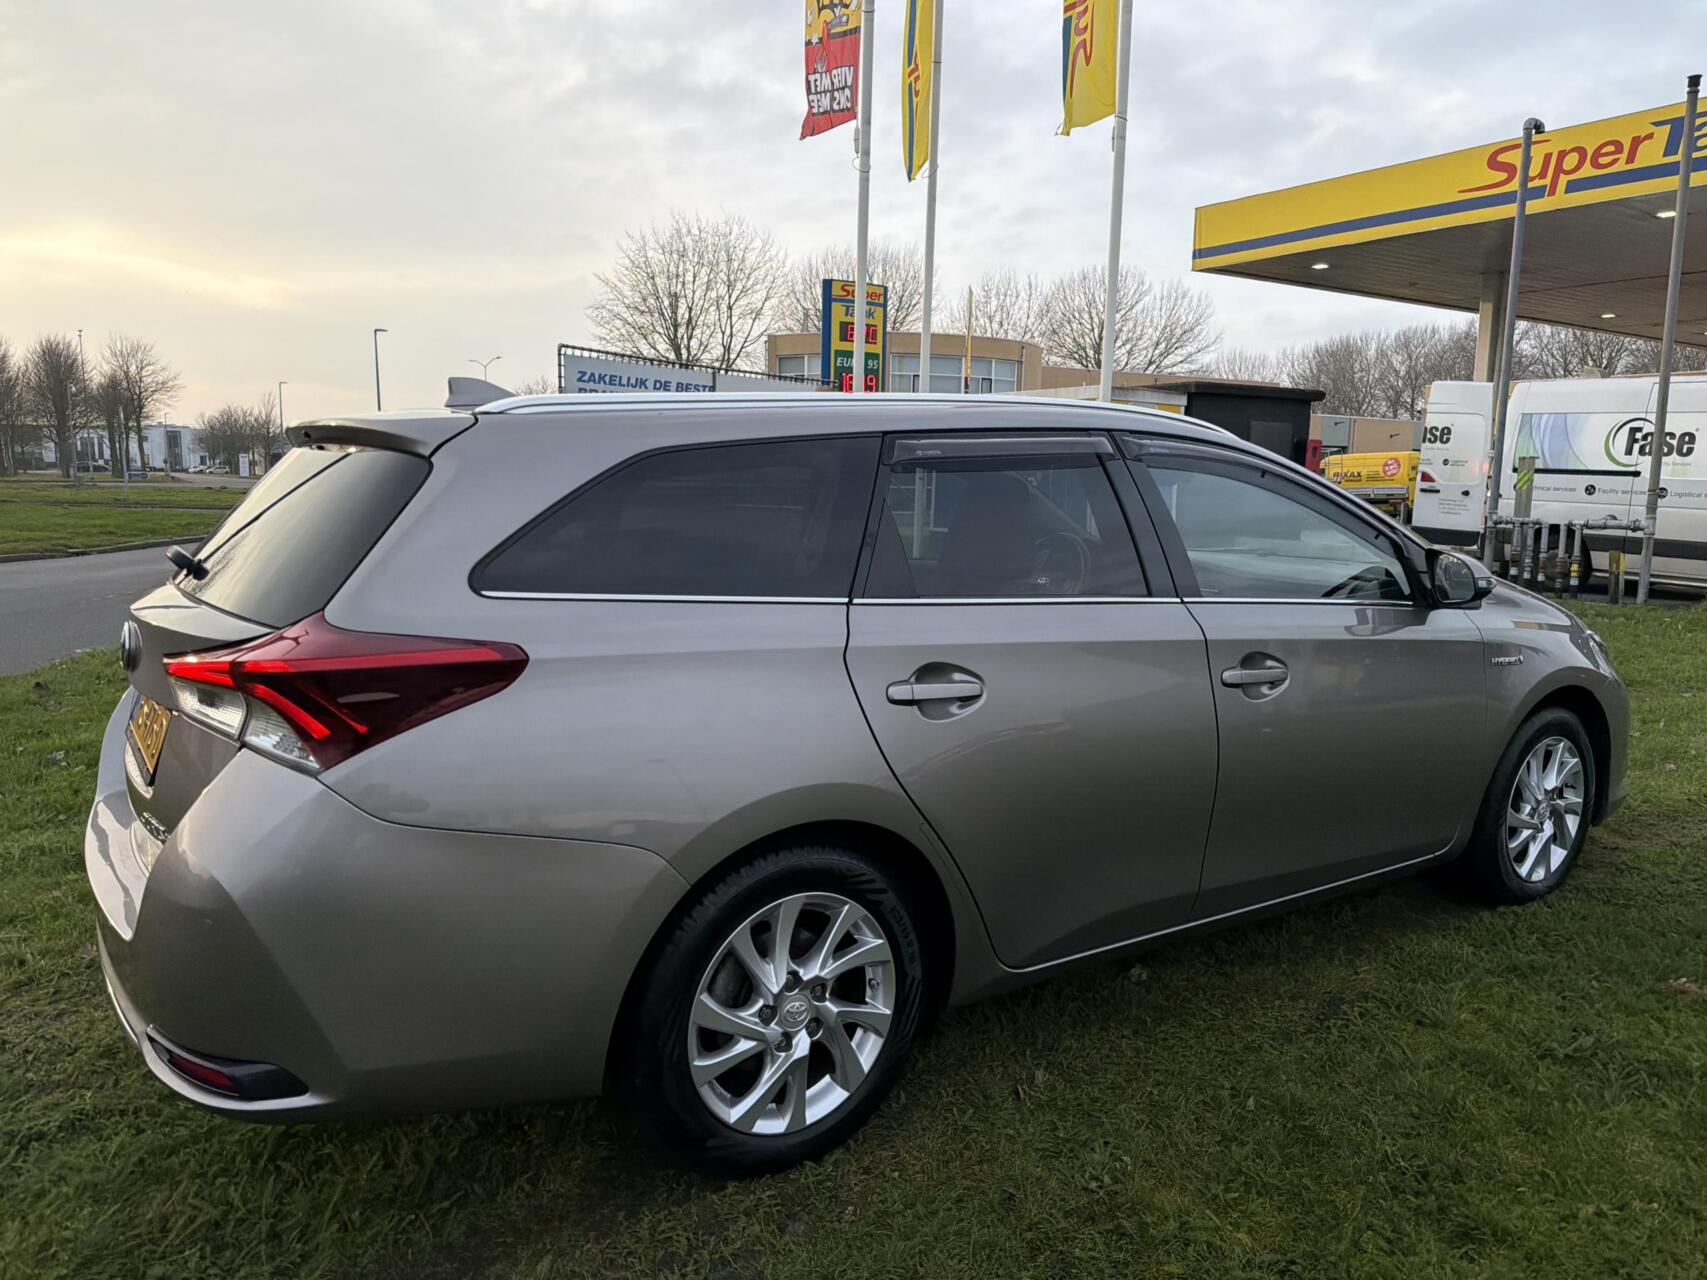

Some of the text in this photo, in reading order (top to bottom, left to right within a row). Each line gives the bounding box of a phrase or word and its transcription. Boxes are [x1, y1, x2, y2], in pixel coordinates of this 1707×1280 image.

[1457, 138, 1655, 197] Super
[832, 284, 884, 302] Ser
[841, 304, 876, 320] Tak
[867, 360, 879, 369] 95
[576, 370, 649, 390] ZAKELIJK
[653, 379, 672, 392] DE
[1624, 426, 1697, 457] Fase
[1598, 487, 1648, 496] Facility services
[1670, 490, 1703, 499] Logistical
